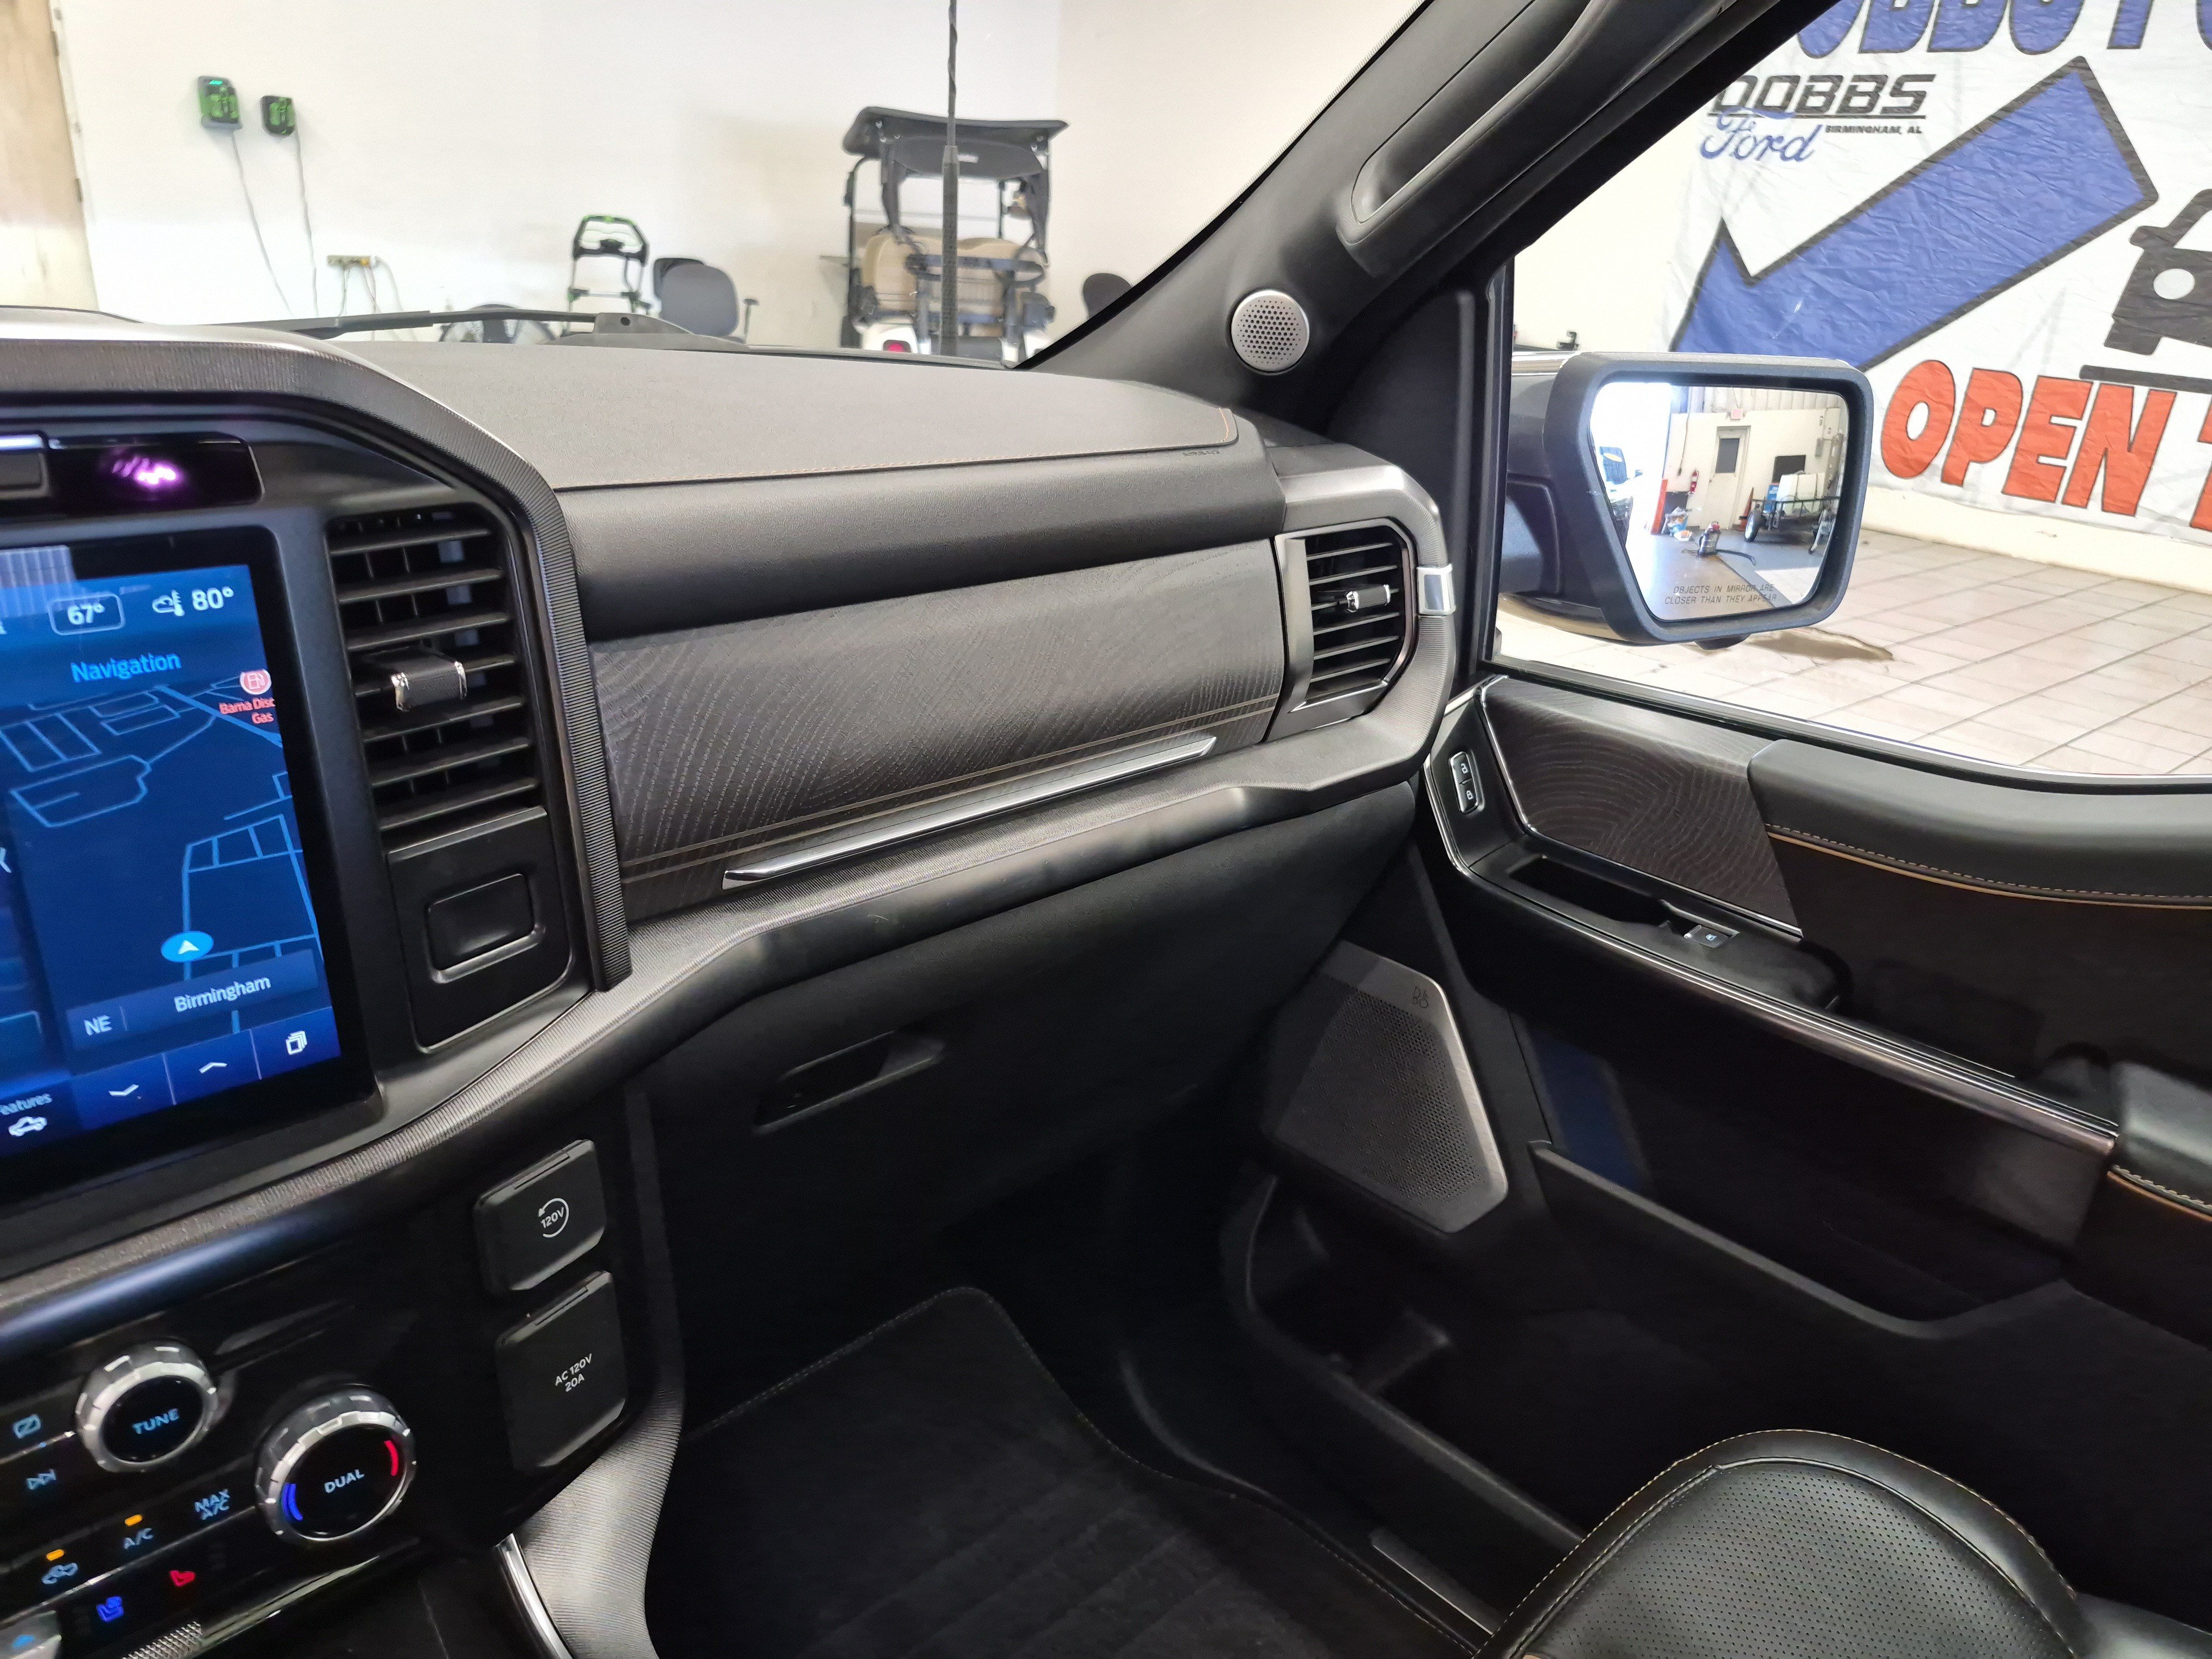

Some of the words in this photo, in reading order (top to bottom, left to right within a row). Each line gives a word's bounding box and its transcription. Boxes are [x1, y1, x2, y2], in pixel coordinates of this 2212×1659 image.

[1712, 74, 1937, 114] DOBBS
[1700, 106, 1824, 162] Ford
[1881, 359, 2177, 517] OPEN
[191, 586, 234, 611] 80°
[1664, 596, 1696, 605] CLOSER
[1701, 595, 1721, 604] THAN
[1725, 594, 1746, 603] THEY
[1747, 593, 1777, 602] APPEAR
[1673, 585, 1710, 594] OBJECTS
[1714, 584, 1722, 593] IN
[1726, 584, 1756, 593] MIRROR
[1759, 583, 1774, 592] ARE
[67, 602, 105, 625] 67°
[70, 652, 182, 684] Navigation
[252, 712, 274, 724] Gas
[173, 976, 272, 1013] Birmingham
[84, 1014, 113, 1036] NE
[541, 1207, 565, 1229] 120V
[555, 1370, 569, 1386] AC
[569, 1353, 593, 1375] 120V
[565, 1373, 585, 1392] 20A
[132, 1409, 180, 1435] TUNE
[324, 1469, 365, 1494] DUAL
[123, 1527, 153, 1550] A/C
